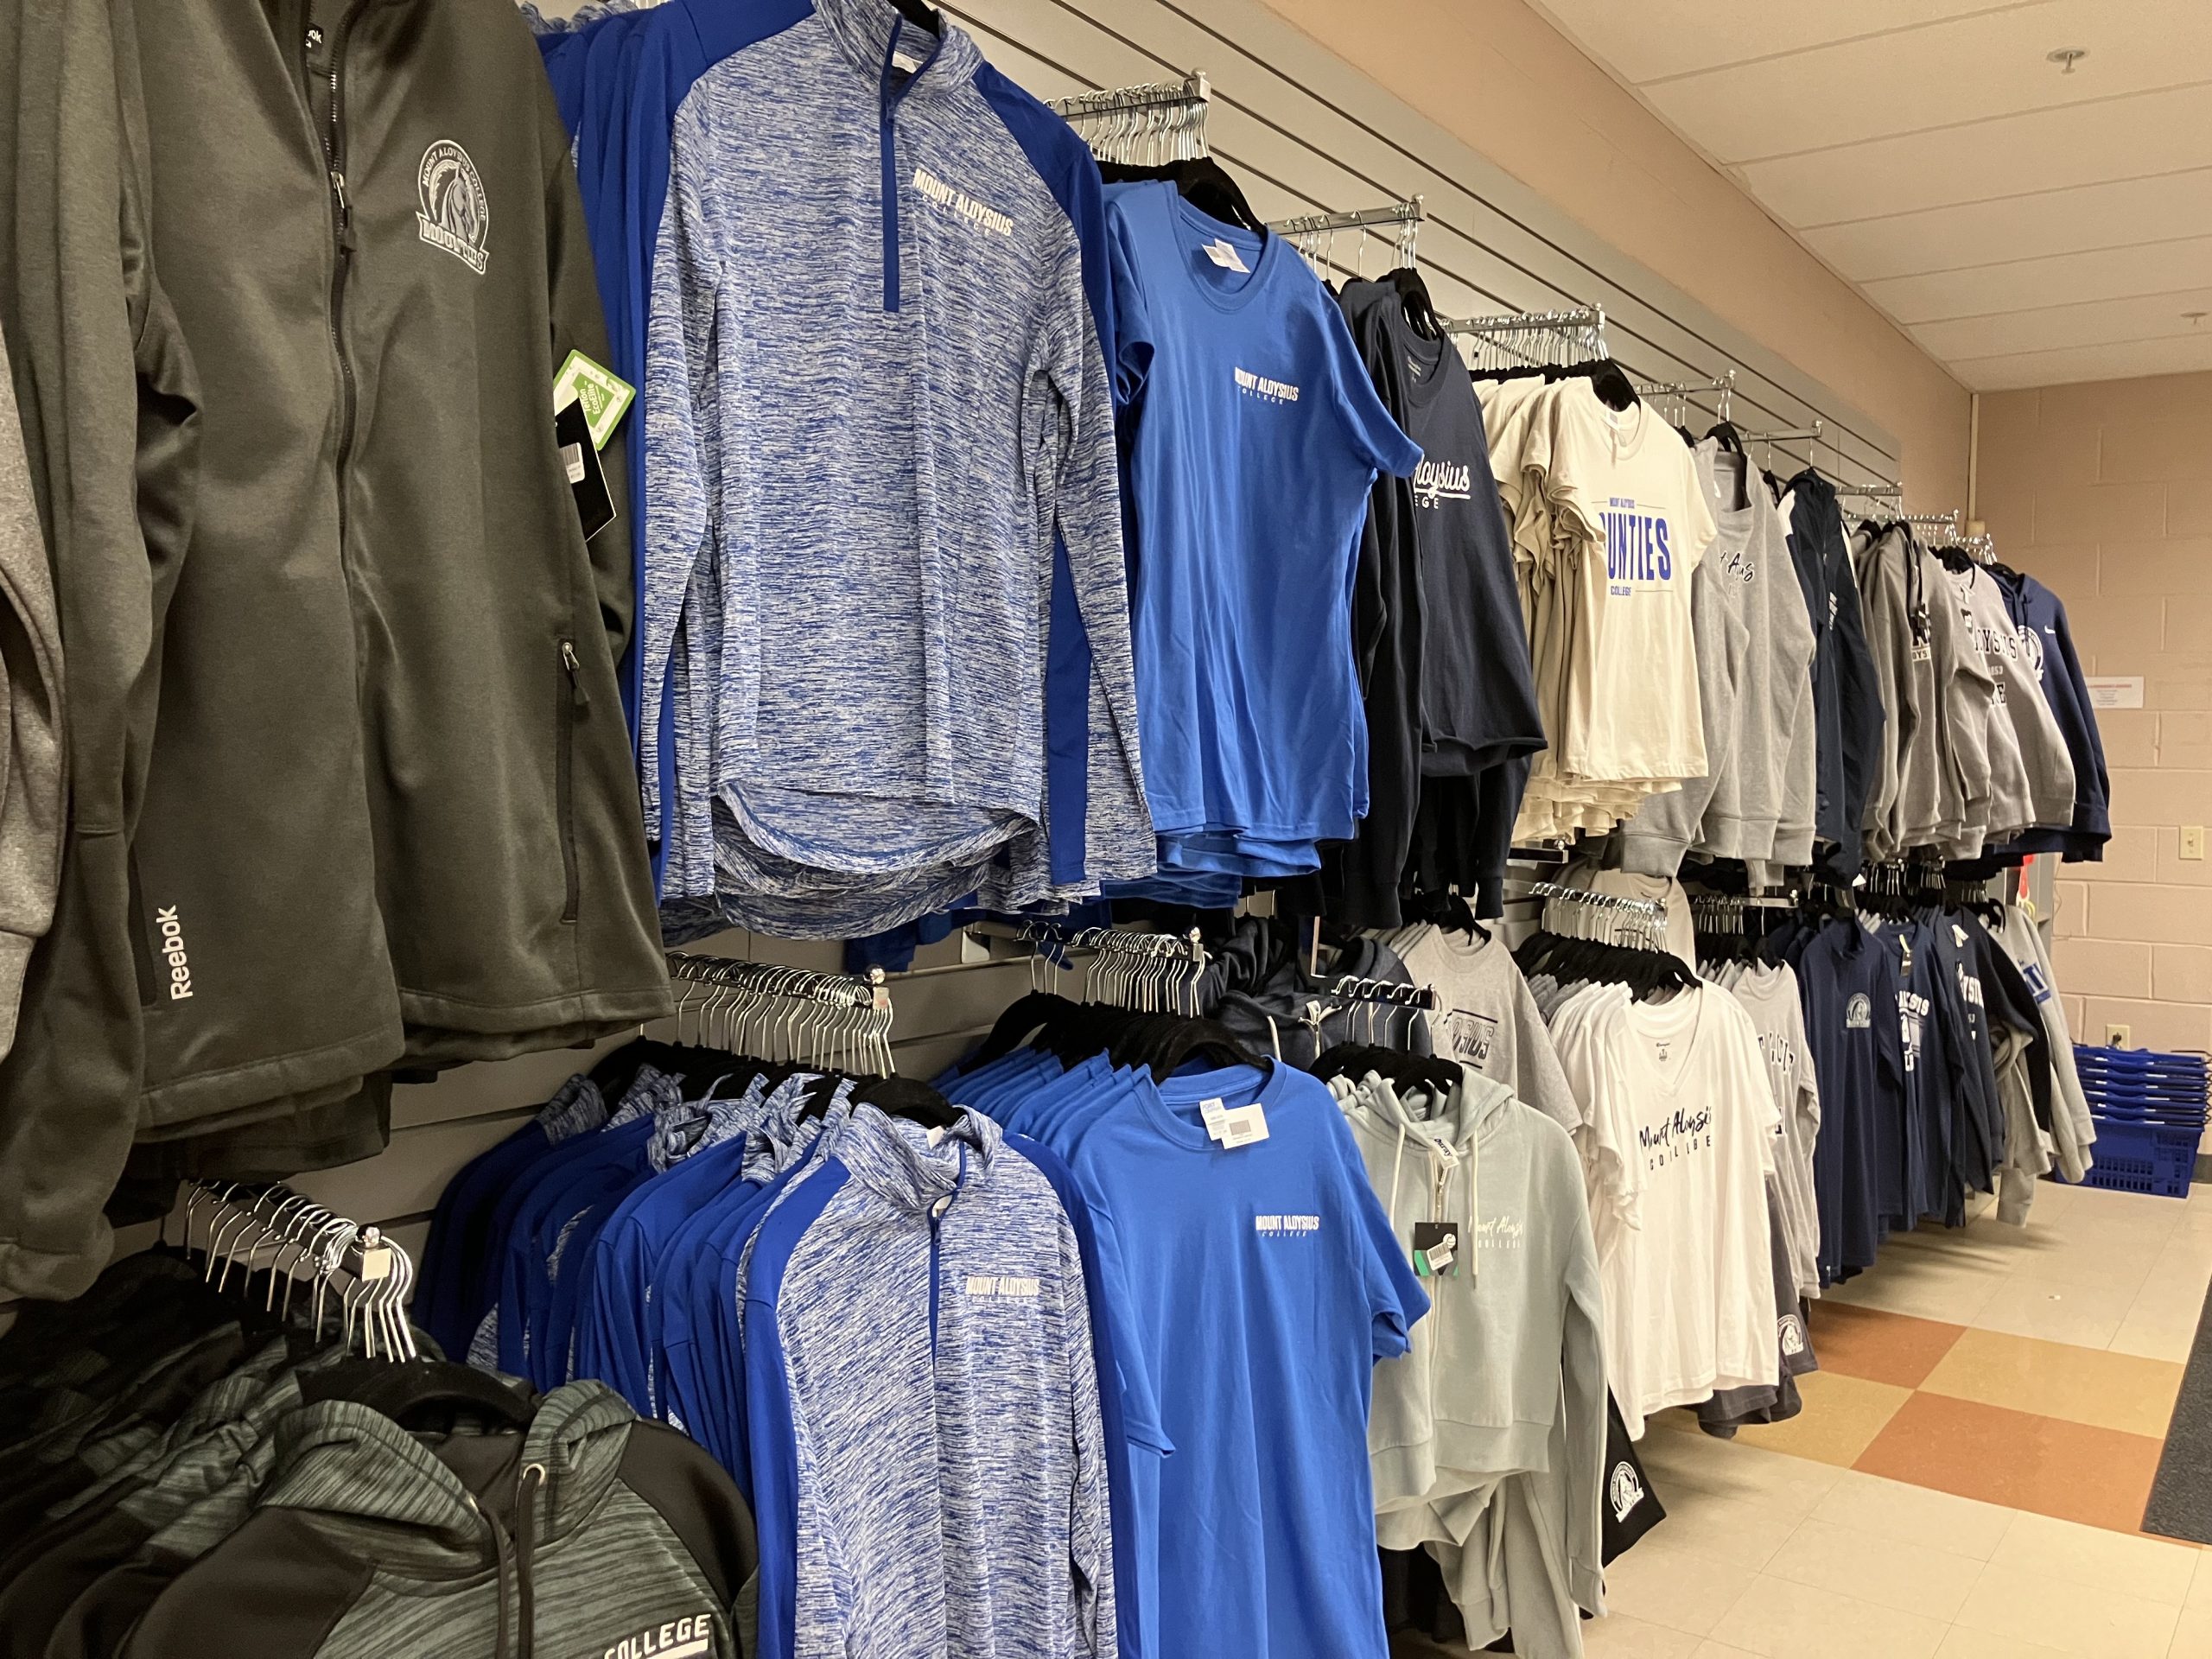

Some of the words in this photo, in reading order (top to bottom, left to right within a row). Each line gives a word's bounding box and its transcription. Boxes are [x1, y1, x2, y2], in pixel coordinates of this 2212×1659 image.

[422, 150, 437, 187] MOUNT
[912, 168, 956, 207] MOUNT
[955, 194, 1014, 237] ALOYSIUS
[922, 194, 992, 236] COLLEGE
[1235, 366, 1258, 391] MOUNT
[1257, 377, 1300, 402] ALOYSIUS
[1414, 461, 1471, 499] loysius
[156, 905, 194, 1001] Reebok
[1639, 1116, 1670, 1152] Munt
[1255, 1215, 1282, 1231] MOUNT
[1282, 1215, 1320, 1231] ALOYSIUS
[965, 1276, 999, 1295] MOUNT
[998, 1275, 1040, 1296] ALOYSIUS
